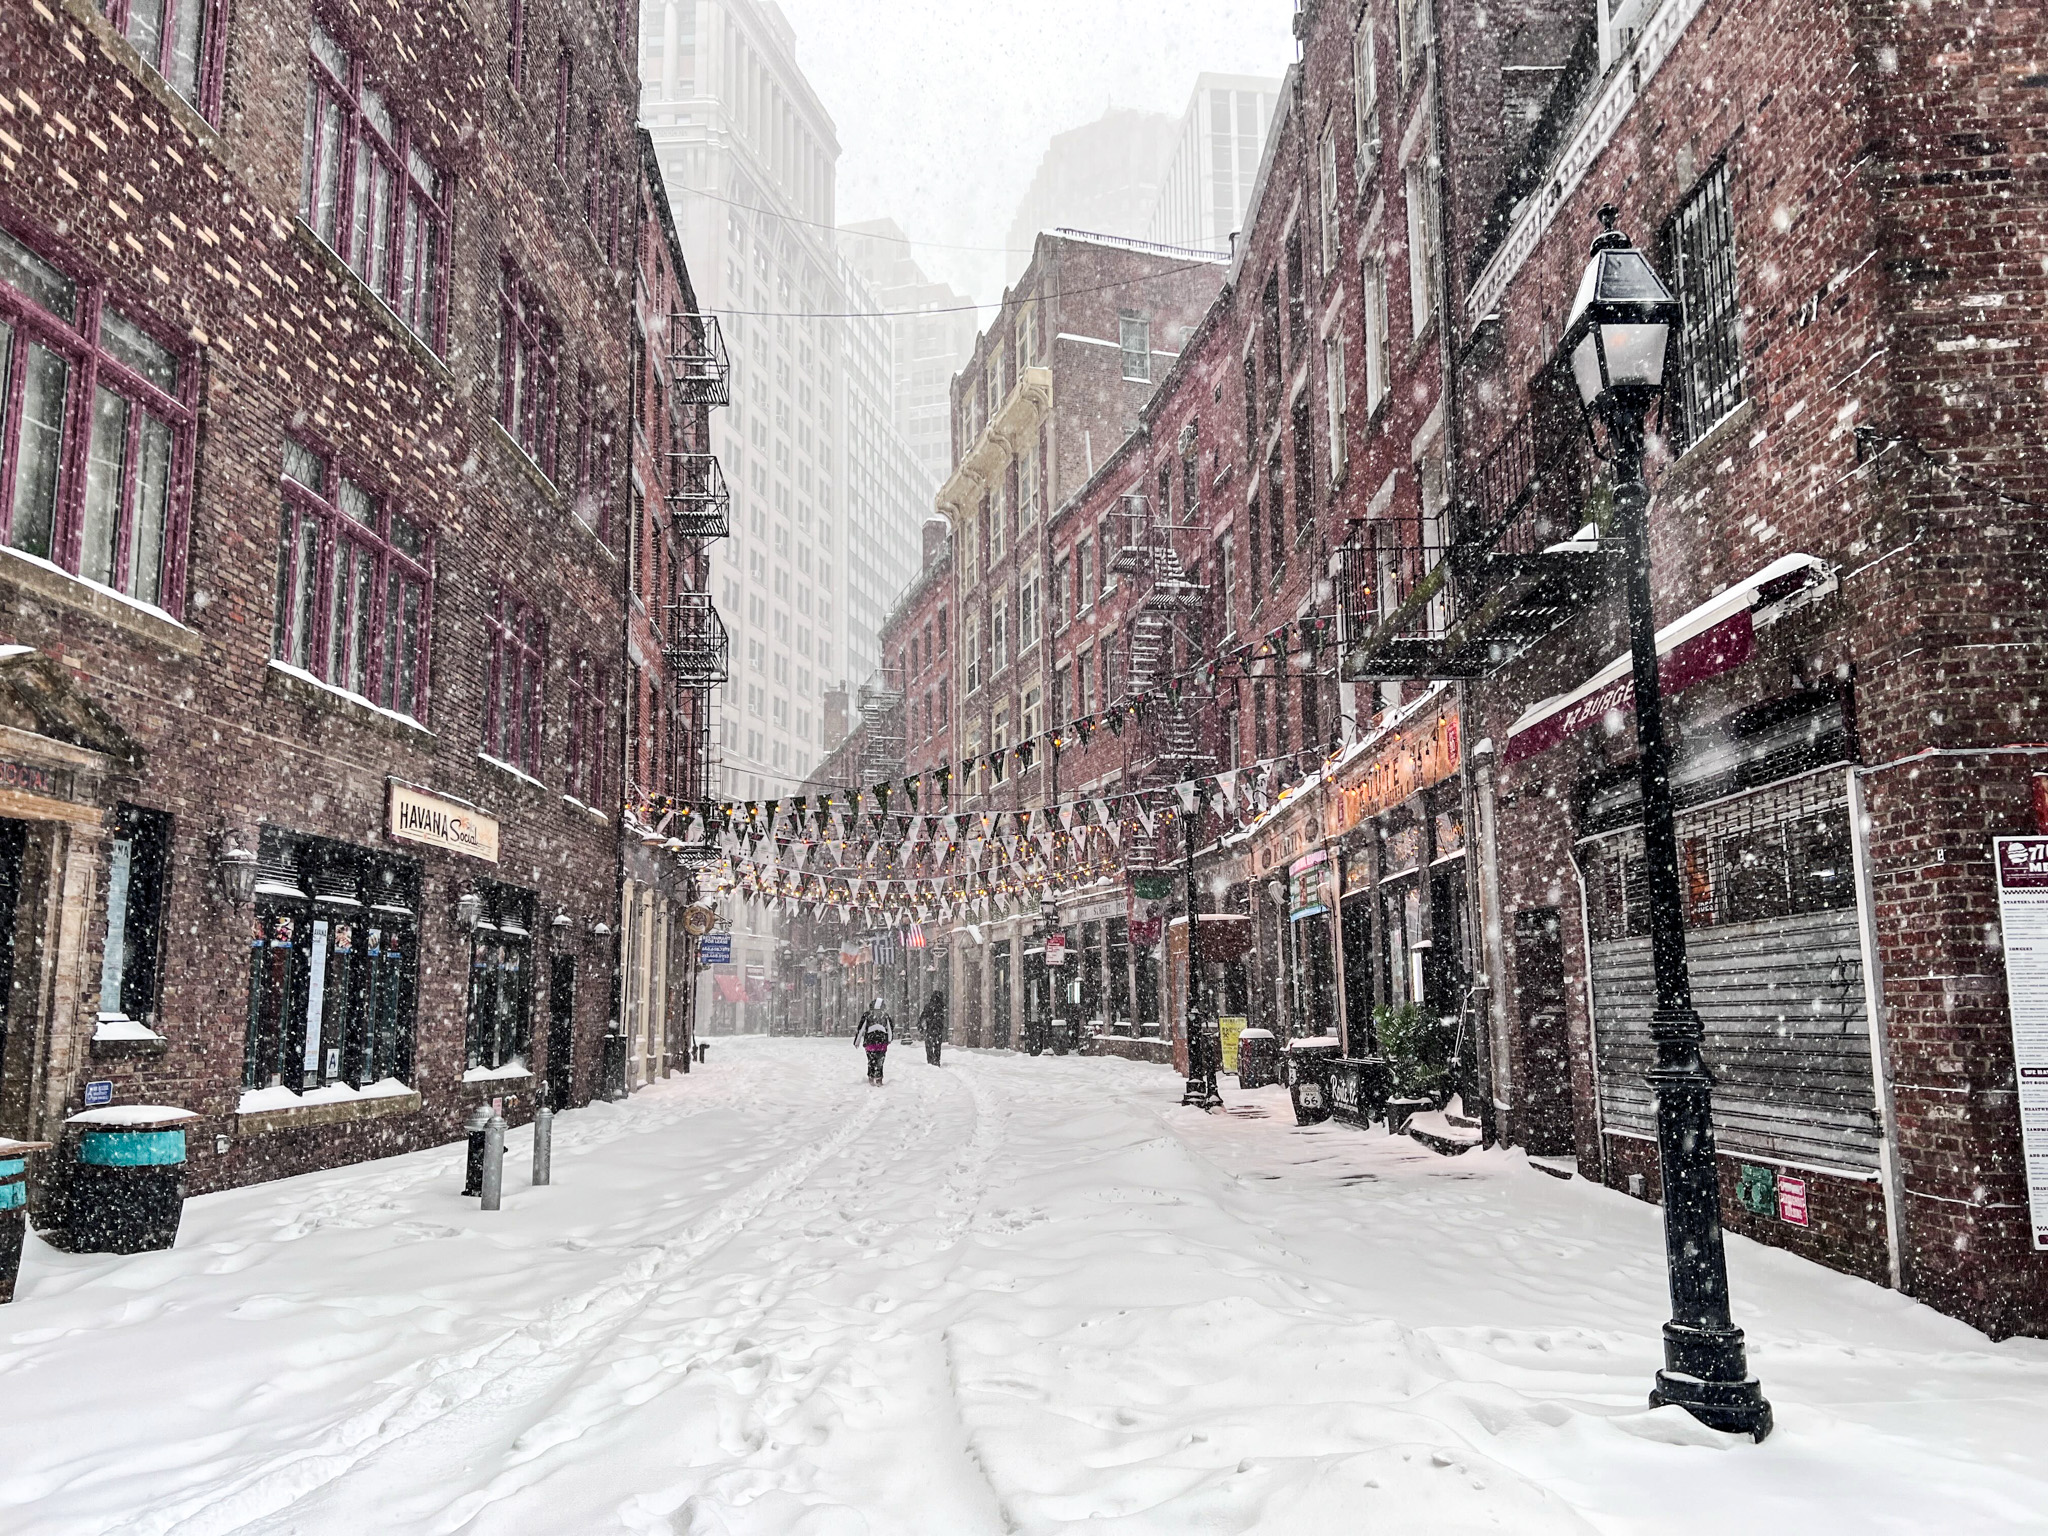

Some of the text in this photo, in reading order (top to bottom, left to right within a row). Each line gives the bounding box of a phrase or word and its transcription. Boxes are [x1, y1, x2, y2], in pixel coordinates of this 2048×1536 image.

[1578, 680, 1635, 723] BURGE
[400, 802, 478, 846] HAVANA Social
[1304, 1096, 1319, 1106] 66
